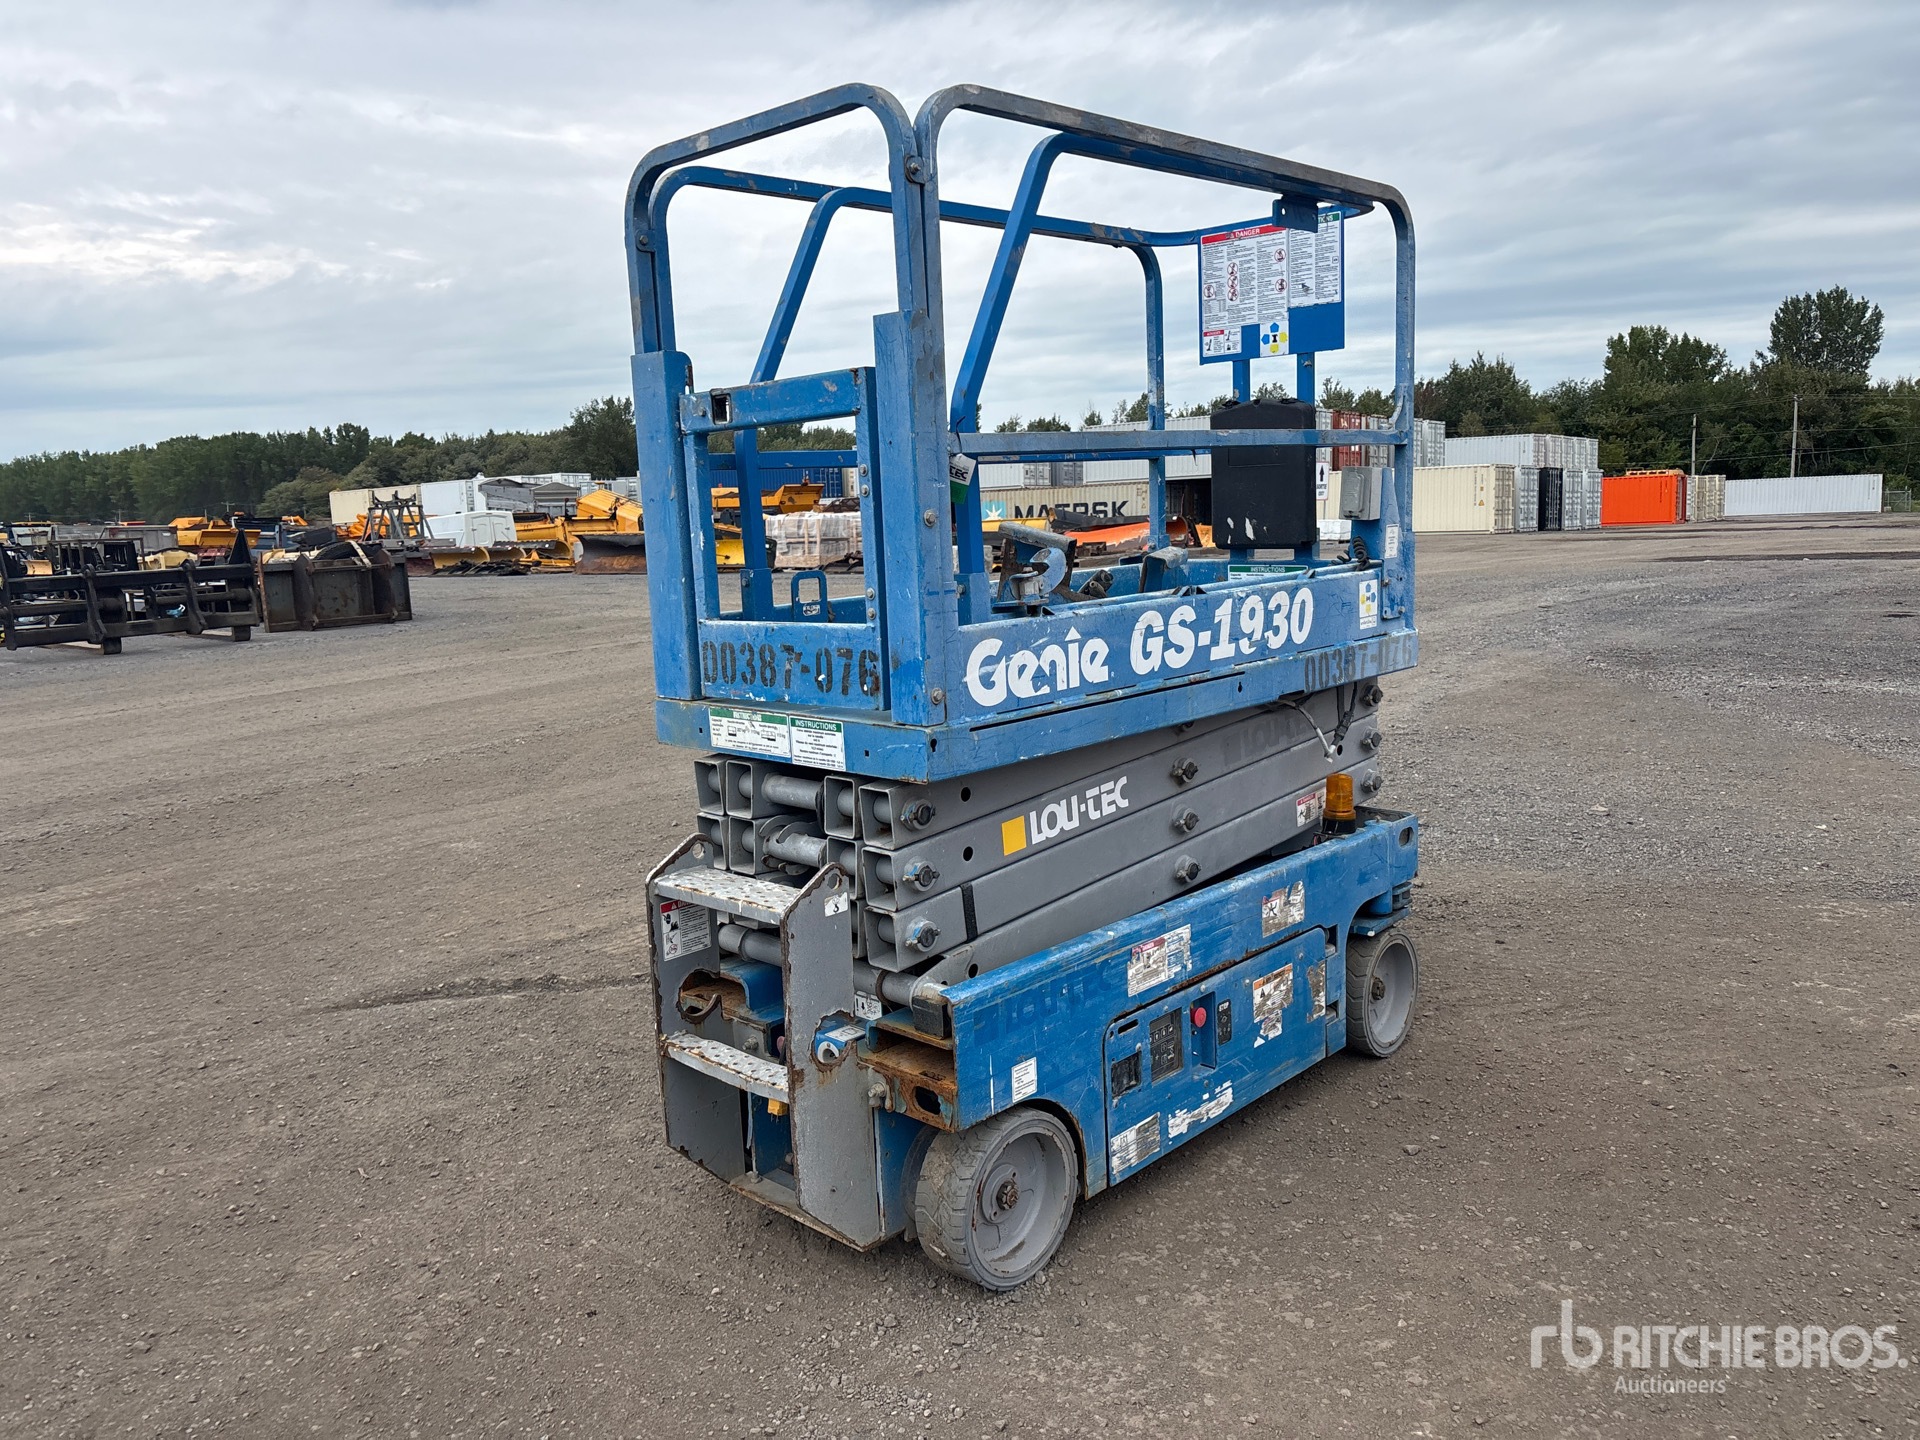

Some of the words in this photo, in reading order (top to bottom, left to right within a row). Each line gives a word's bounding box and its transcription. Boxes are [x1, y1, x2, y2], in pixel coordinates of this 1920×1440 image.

[1237, 228, 1261, 239] DANGER
[1250, 566, 1286, 574] INSTRUCTIONS
[965, 626, 1110, 707] Genie
[1130, 586, 1315, 676] GS-1930
[702, 640, 881, 697] 00387-076
[795, 719, 837, 732] INSTRUCTIONS
[1030, 775, 1130, 845] LOU-TEC
[1218, 1001, 1230, 1012] STOP
